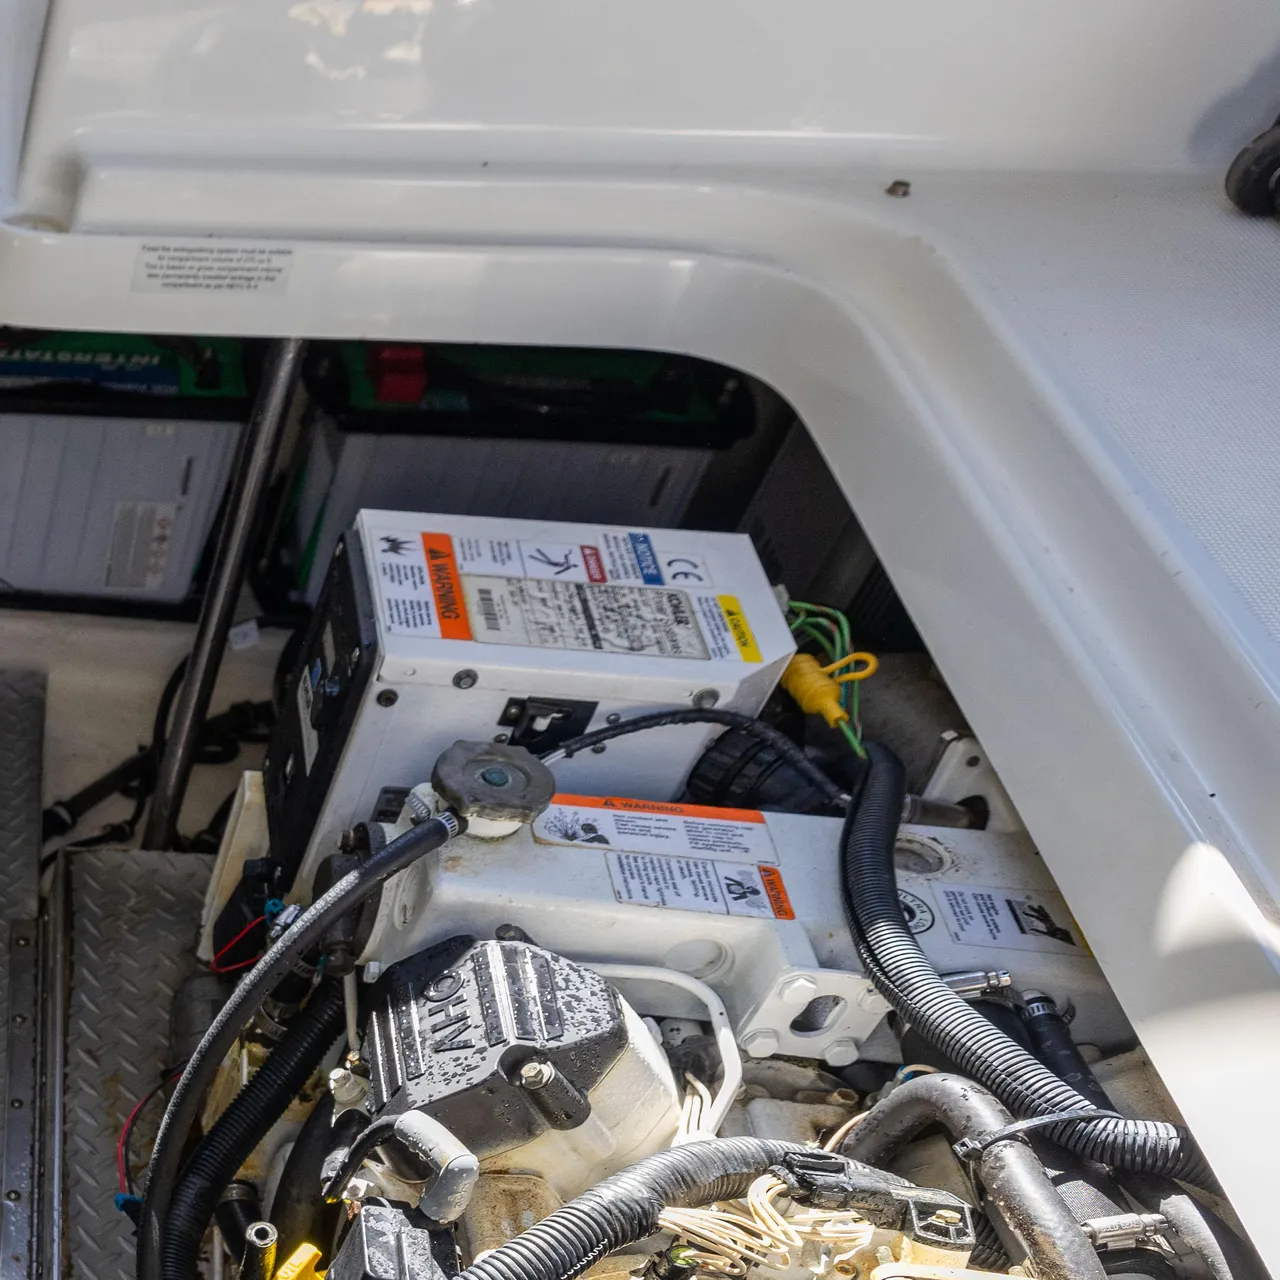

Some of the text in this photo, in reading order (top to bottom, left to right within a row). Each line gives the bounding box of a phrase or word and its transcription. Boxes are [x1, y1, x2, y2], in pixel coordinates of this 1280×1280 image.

[632, 543, 658, 575] NOTICE
[430, 562, 460, 619] WARNING
[621, 802, 684, 813] WARNING
[765, 879, 787, 916] WARNING
[421, 968, 476, 1054] OHV
[280, 1260, 303, 1280] OIL
